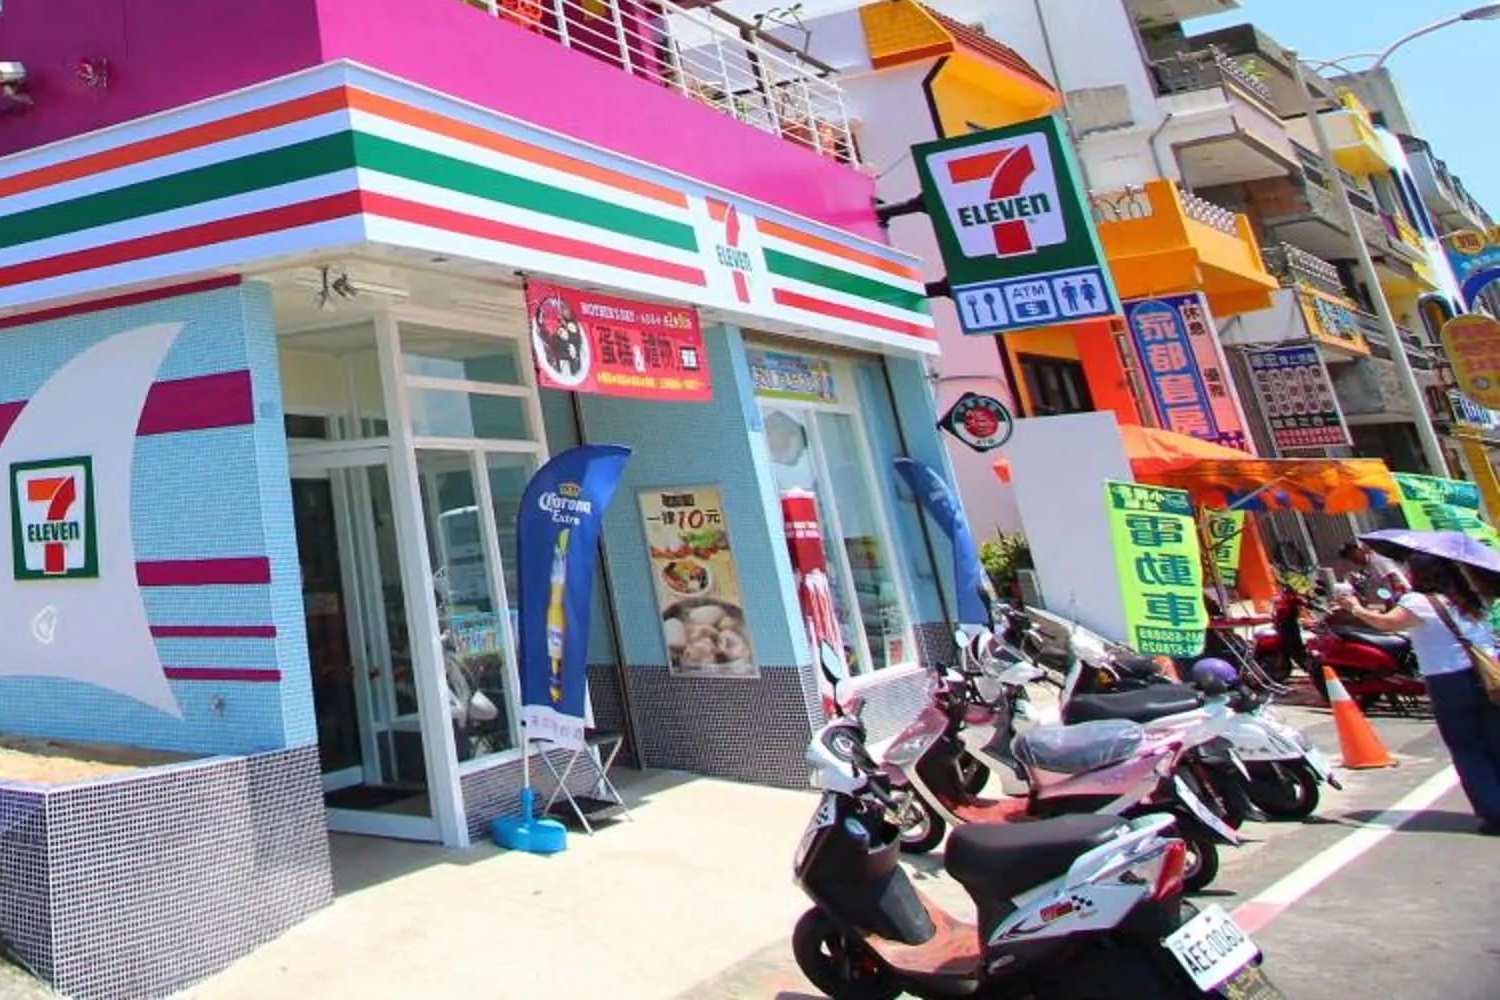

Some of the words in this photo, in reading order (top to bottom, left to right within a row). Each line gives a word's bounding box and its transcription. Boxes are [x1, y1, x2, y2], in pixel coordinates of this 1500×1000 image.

[1011, 284, 1046, 299] ATM
[538, 490, 593, 515] Corona
[551, 509, 580, 525] Extra
